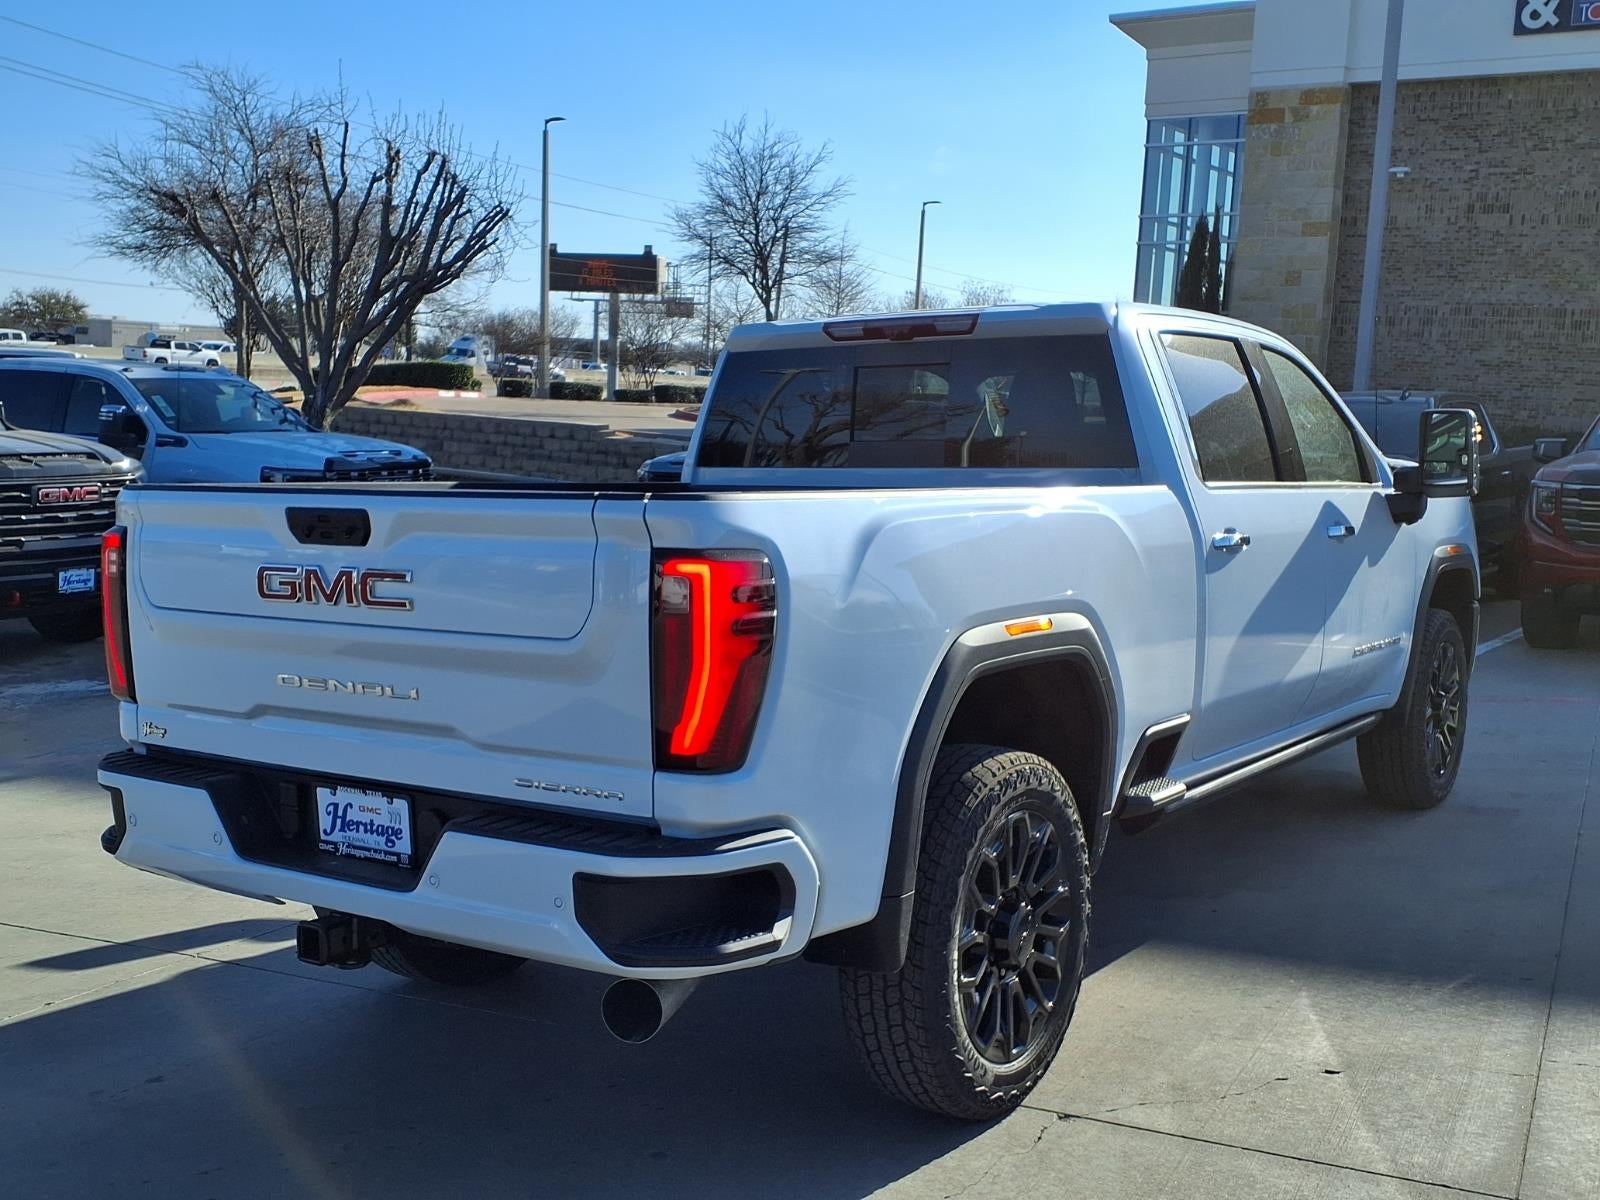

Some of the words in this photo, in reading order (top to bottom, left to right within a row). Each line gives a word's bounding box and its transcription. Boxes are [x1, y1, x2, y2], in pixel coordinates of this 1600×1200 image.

[39, 487, 99, 502] GMC
[257, 563, 414, 611] GMC
[276, 673, 419, 700] DENALI
[512, 778, 624, 801] SIERRA
[358, 805, 382, 815] GMC
[322, 802, 404, 848] Heritage
[319, 842, 335, 851] GMC
